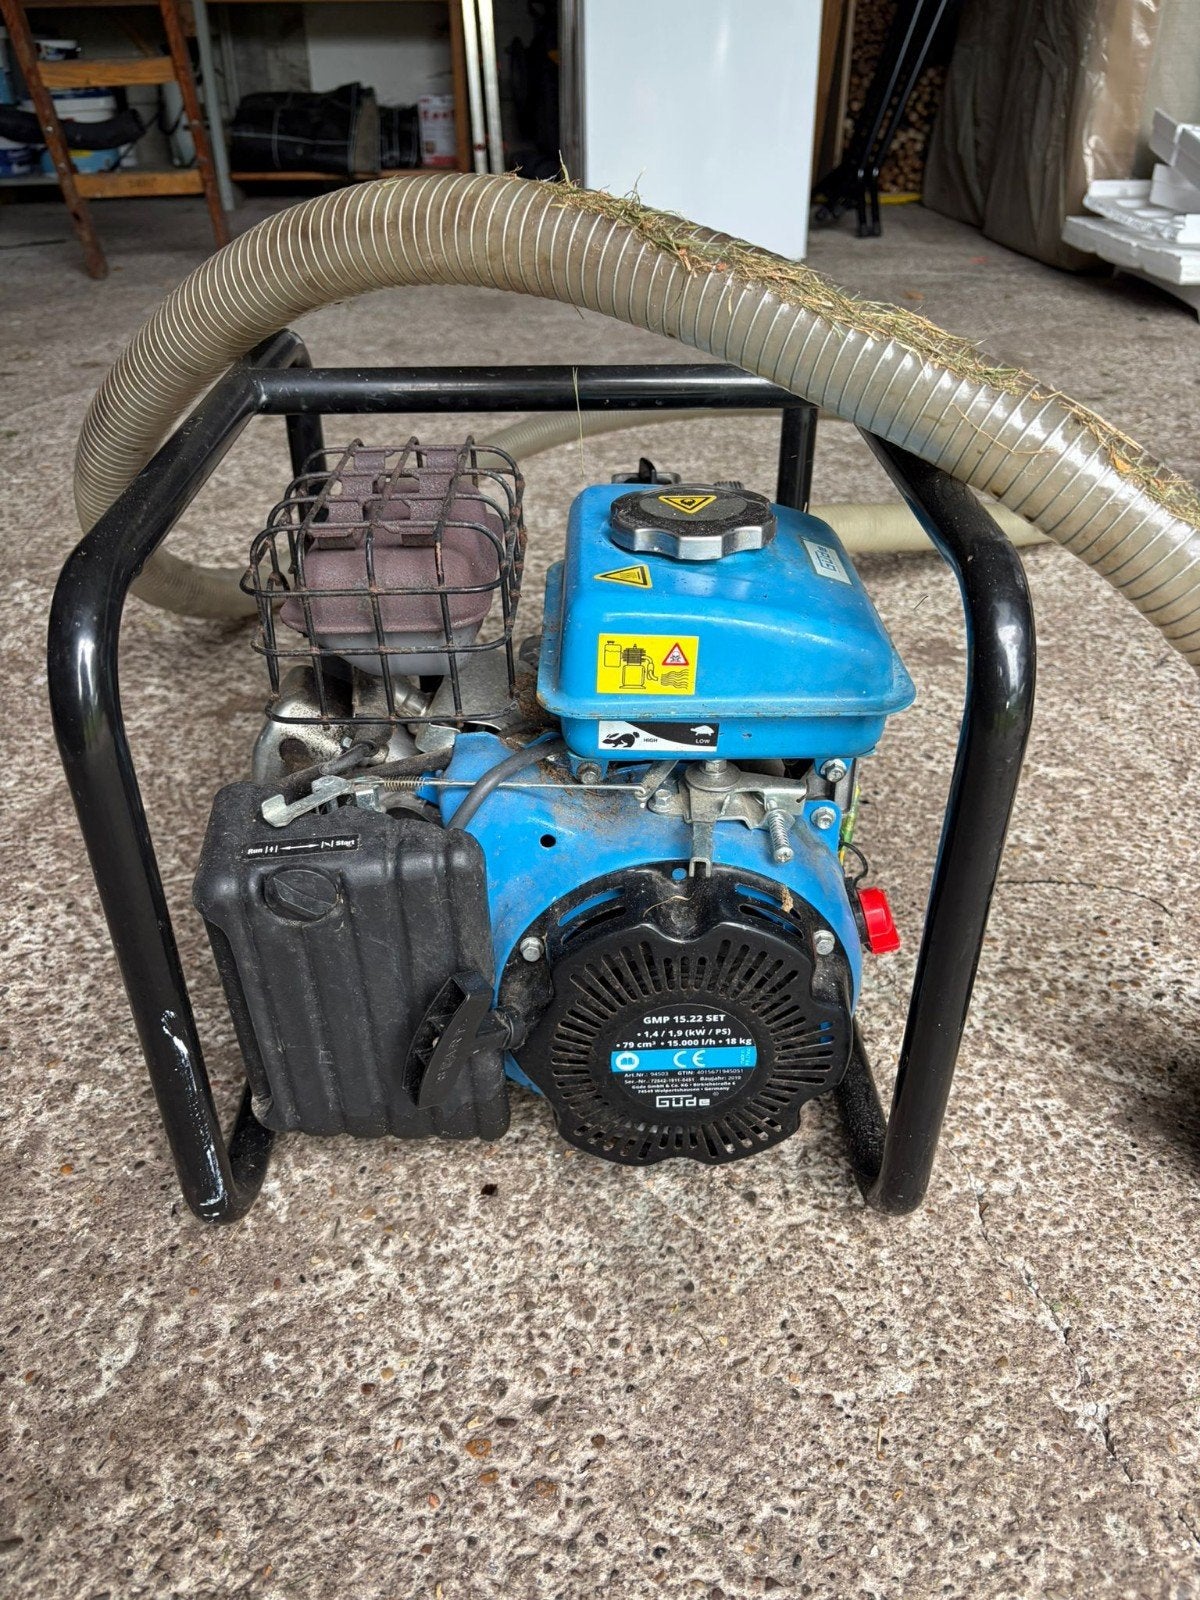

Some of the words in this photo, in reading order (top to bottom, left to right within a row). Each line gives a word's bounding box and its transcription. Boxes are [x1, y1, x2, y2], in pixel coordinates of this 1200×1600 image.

[335, 839, 355, 847] Start
[643, 1016, 670, 1025] GMP
[673, 1015, 703, 1023] 15.22
[705, 1014, 726, 1022] SET
[643, 1030, 659, 1038] 1,4
[668, 1029, 684, 1038] 1,9
[685, 1028, 706, 1037] (kW
[715, 1027, 732, 1036] PS)
[667, 1039, 699, 1047] 15.000
[701, 1038, 716, 1046] l/h
[725, 1037, 737, 1045] 18
[738, 1037, 752, 1046] kg
[656, 1094, 710, 1108] Güde
